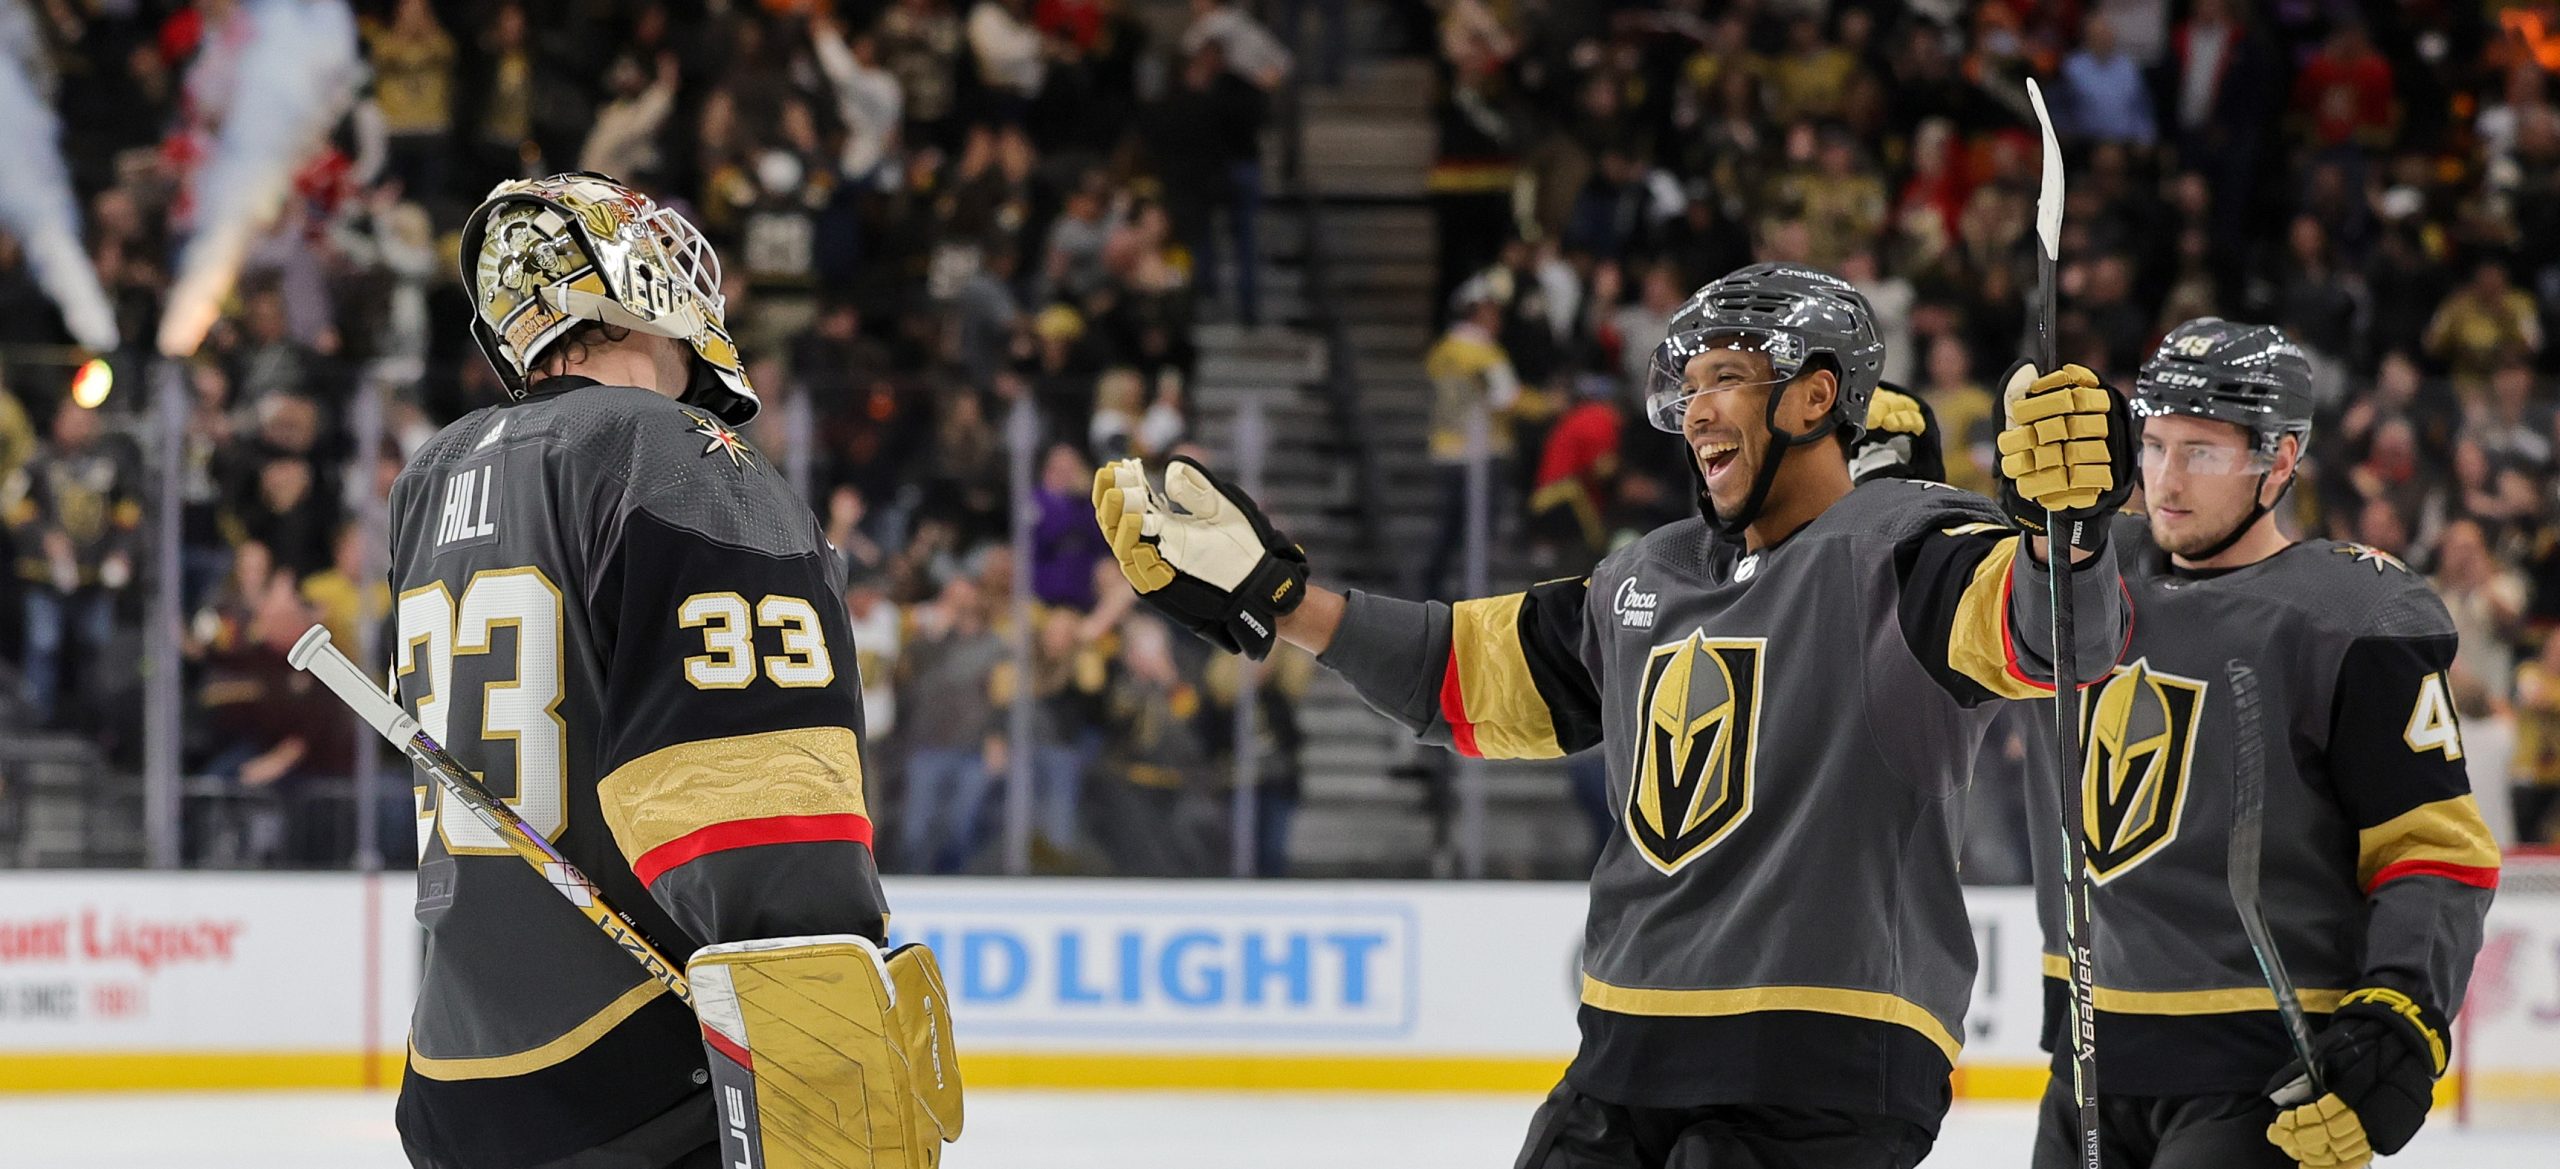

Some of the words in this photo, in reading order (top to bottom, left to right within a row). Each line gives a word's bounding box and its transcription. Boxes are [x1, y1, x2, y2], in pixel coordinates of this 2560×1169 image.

[2156, 371, 2208, 389] CCM
[2176, 335, 2215, 357] 49
[436, 465, 495, 547] HILL
[1614, 577, 1657, 615] Circa
[1623, 610, 1654, 627] SPORTS
[677, 591, 835, 690] 33
[396, 565, 569, 866] 33
[2402, 671, 2463, 762] 4
[411, 748, 500, 831] TRUE
[80, 905, 246, 976] Liquor
[598, 912, 694, 1006] HZRD
[618, 910, 637, 928] HILL
[1056, 927, 1387, 1007] LIGHT
